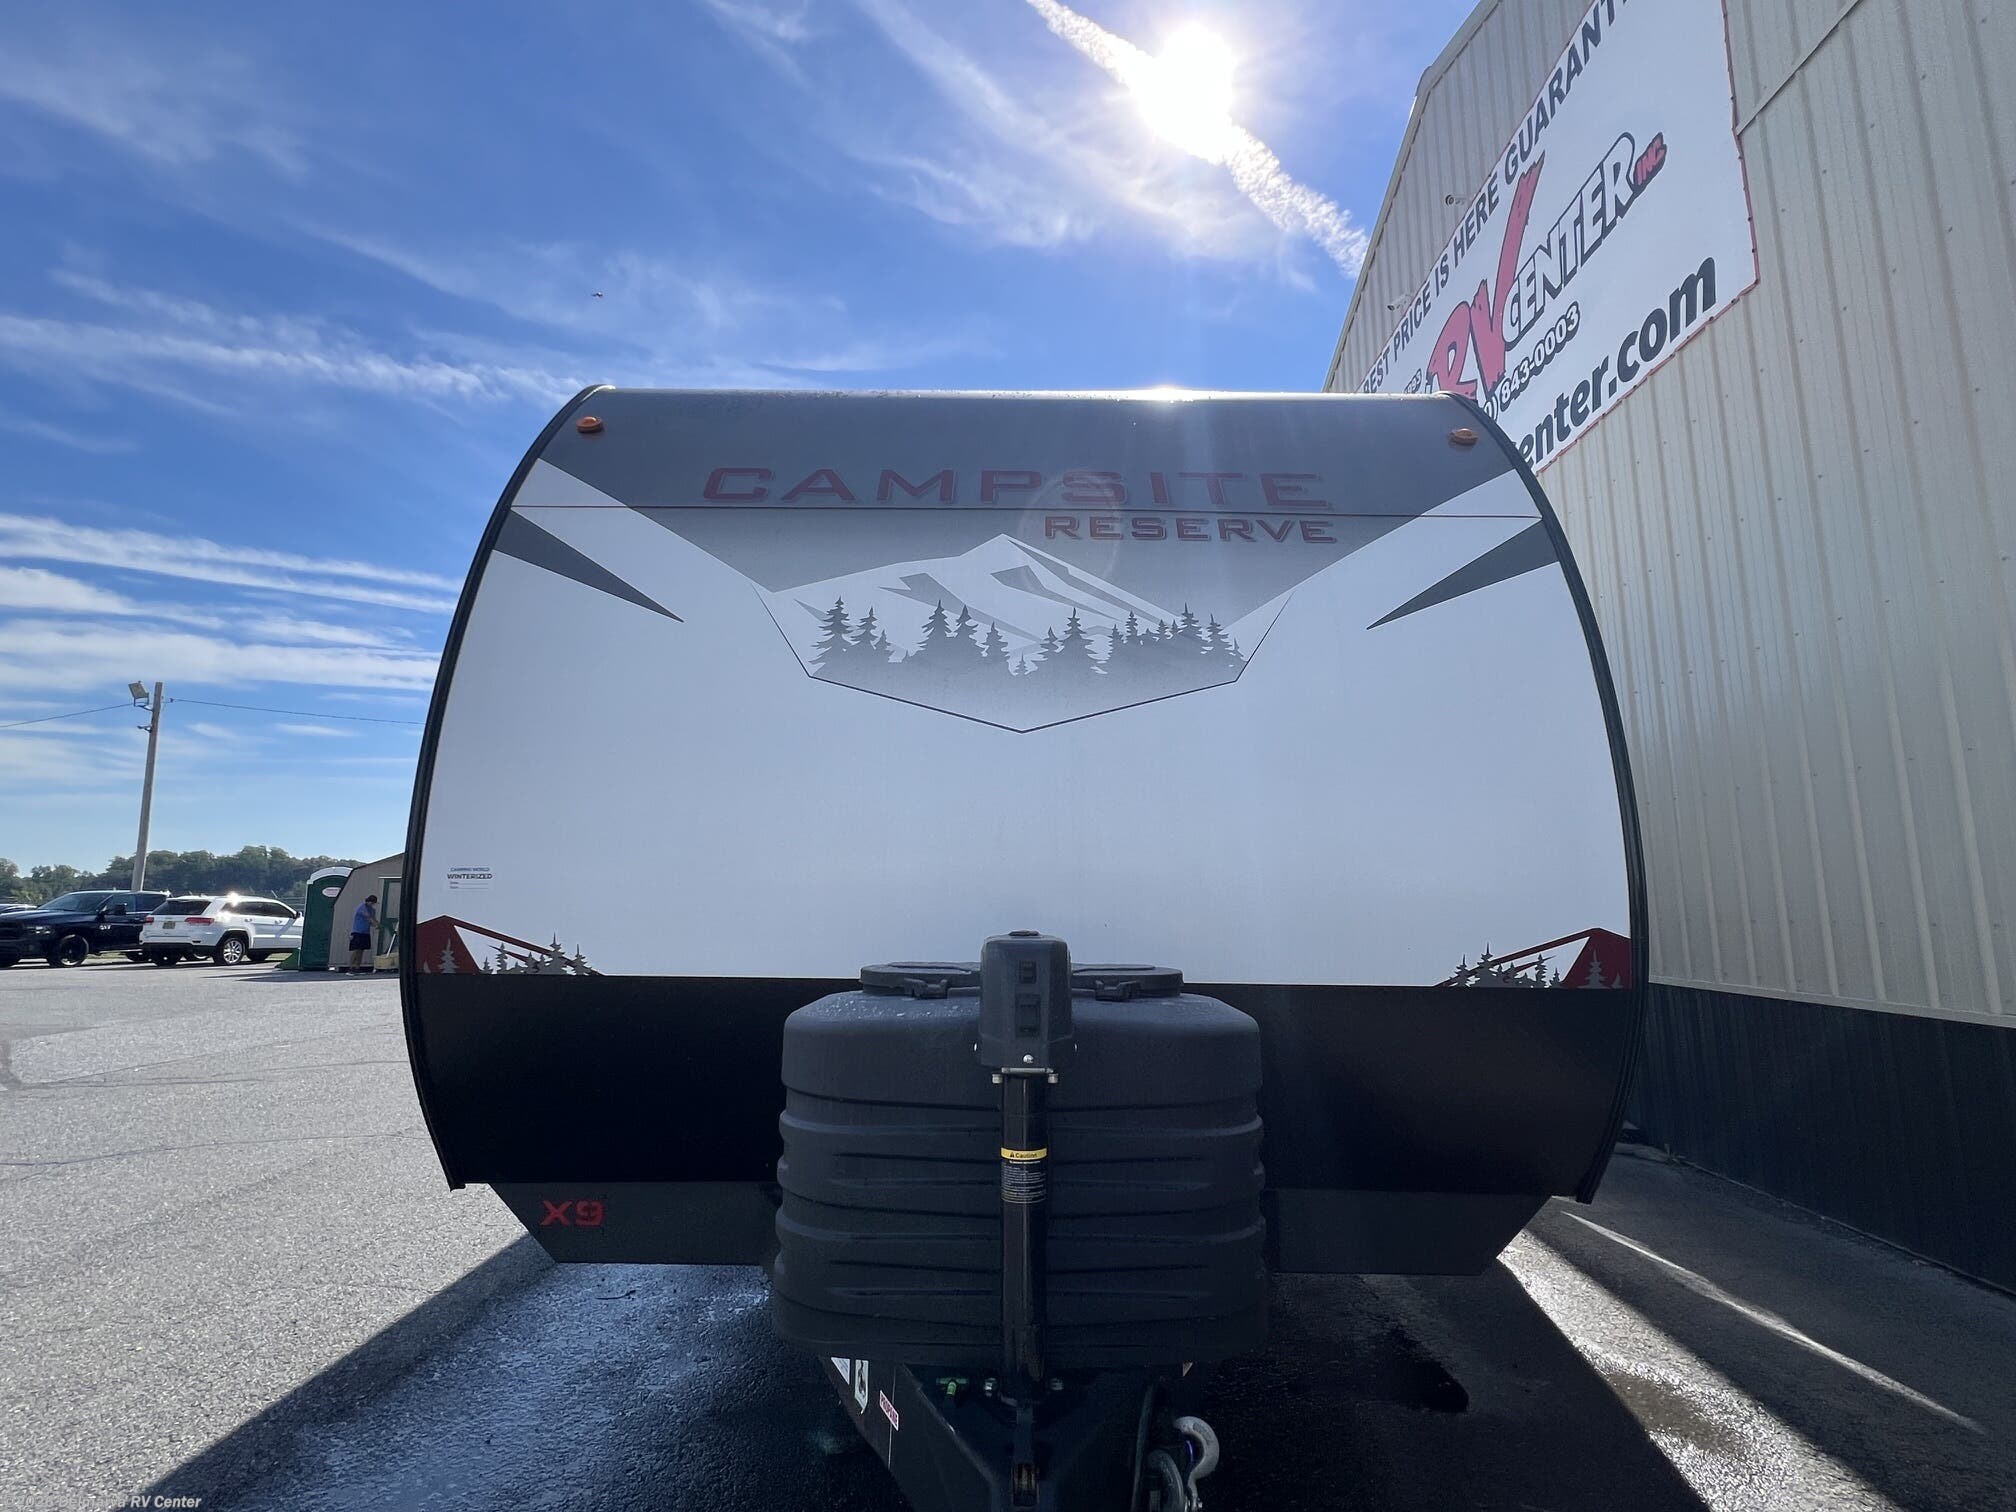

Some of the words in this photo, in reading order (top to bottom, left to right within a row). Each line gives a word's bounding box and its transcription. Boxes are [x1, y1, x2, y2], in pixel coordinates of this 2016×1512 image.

[1393, 280, 1432, 363] PRICE
[1434, 253, 1450, 298] IS
[1453, 171, 1500, 269] HERE
[1505, 0, 1628, 185] GUARANT
[1425, 150, 1546, 401] RV
[1502, 131, 1636, 352] CENTER
[1500, 301, 1580, 412] 843-0003
[1512, 257, 1717, 471] enter.com
[703, 467, 1334, 511] CAMPSITE
[1045, 515, 1338, 544] RESERVE
[540, 1200, 604, 1227] X9
